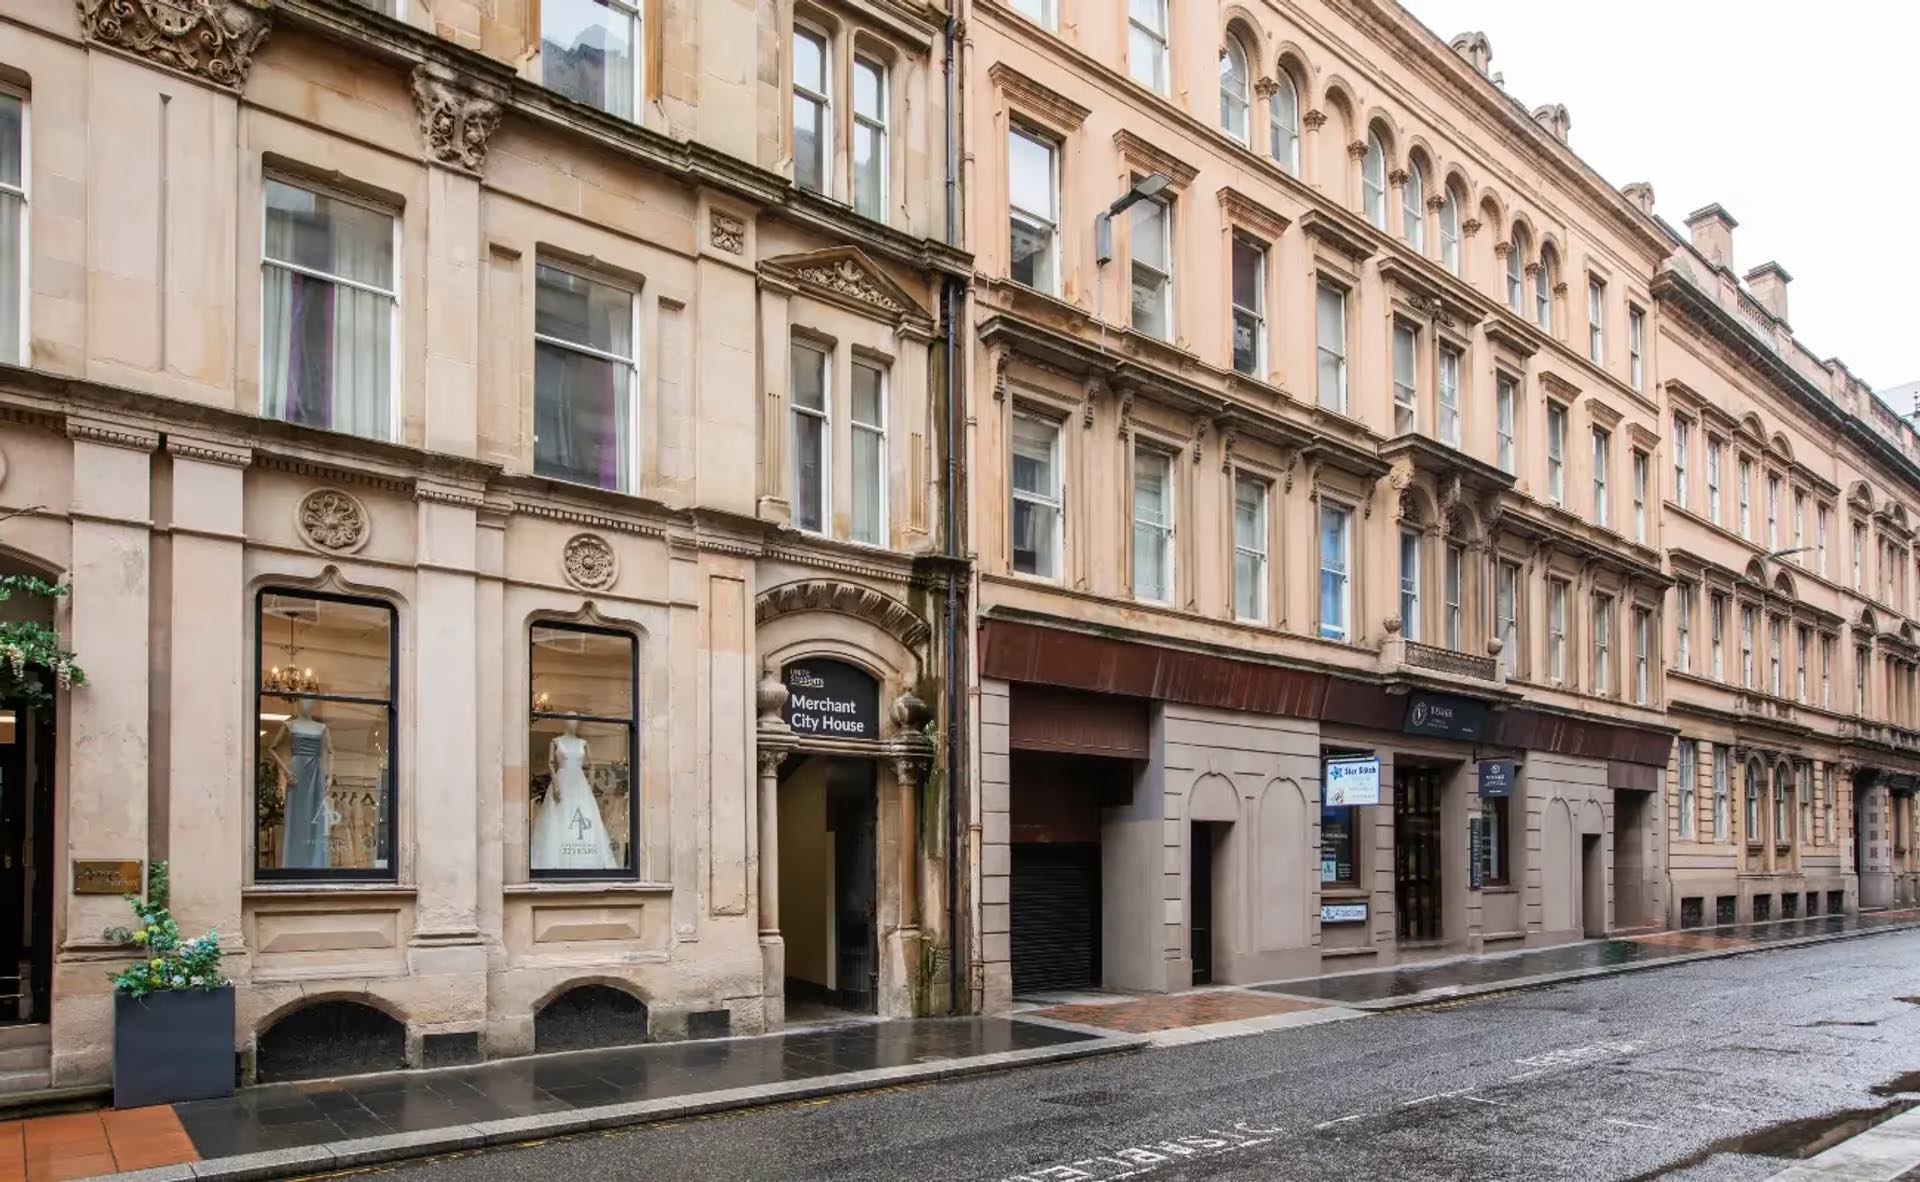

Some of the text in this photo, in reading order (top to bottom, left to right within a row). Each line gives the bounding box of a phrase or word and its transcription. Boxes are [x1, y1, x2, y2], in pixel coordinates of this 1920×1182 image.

[791, 694, 856, 714] Merchant
[791, 713, 864, 732] City House
